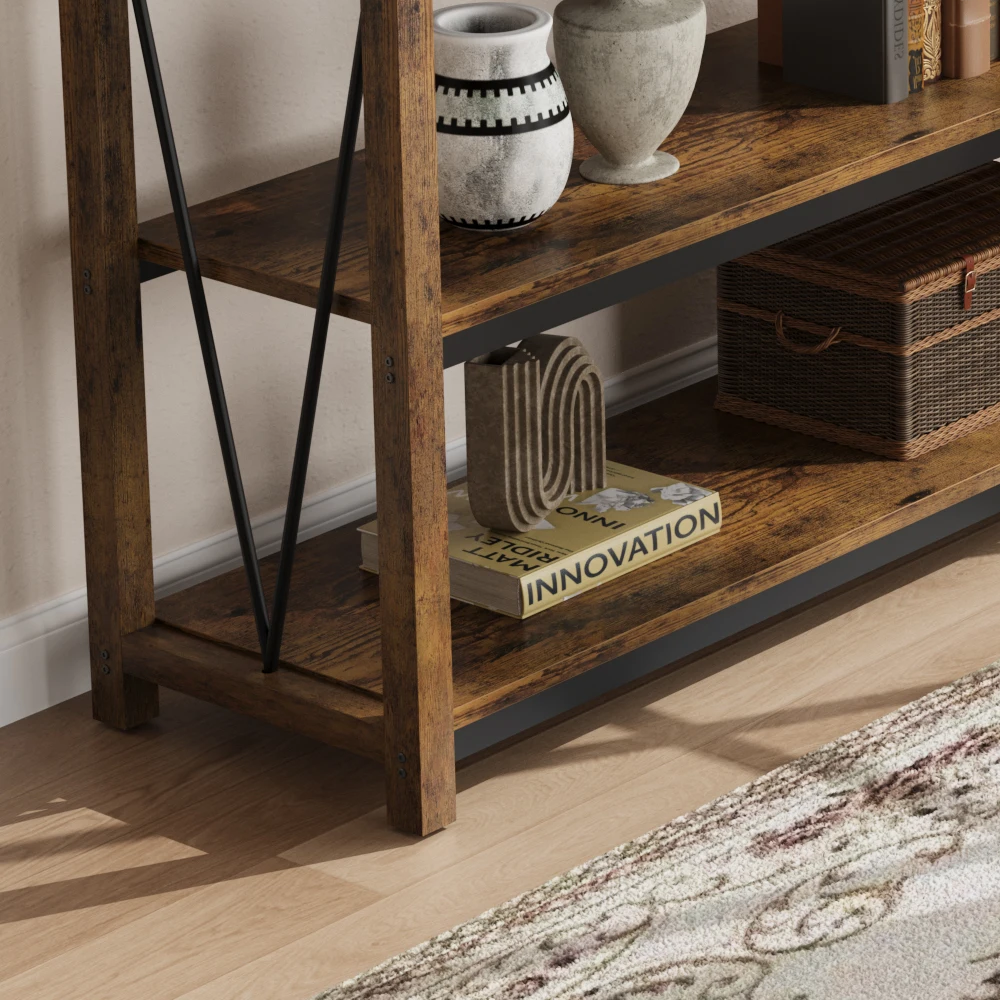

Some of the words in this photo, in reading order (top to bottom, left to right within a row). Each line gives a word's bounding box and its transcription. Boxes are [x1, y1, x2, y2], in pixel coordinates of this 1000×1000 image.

[555, 506, 626, 530] INNO
[462, 546, 540, 572] MATT
[465, 533, 558, 564] RIDLEY
[526, 501, 720, 606] INNOVATION
